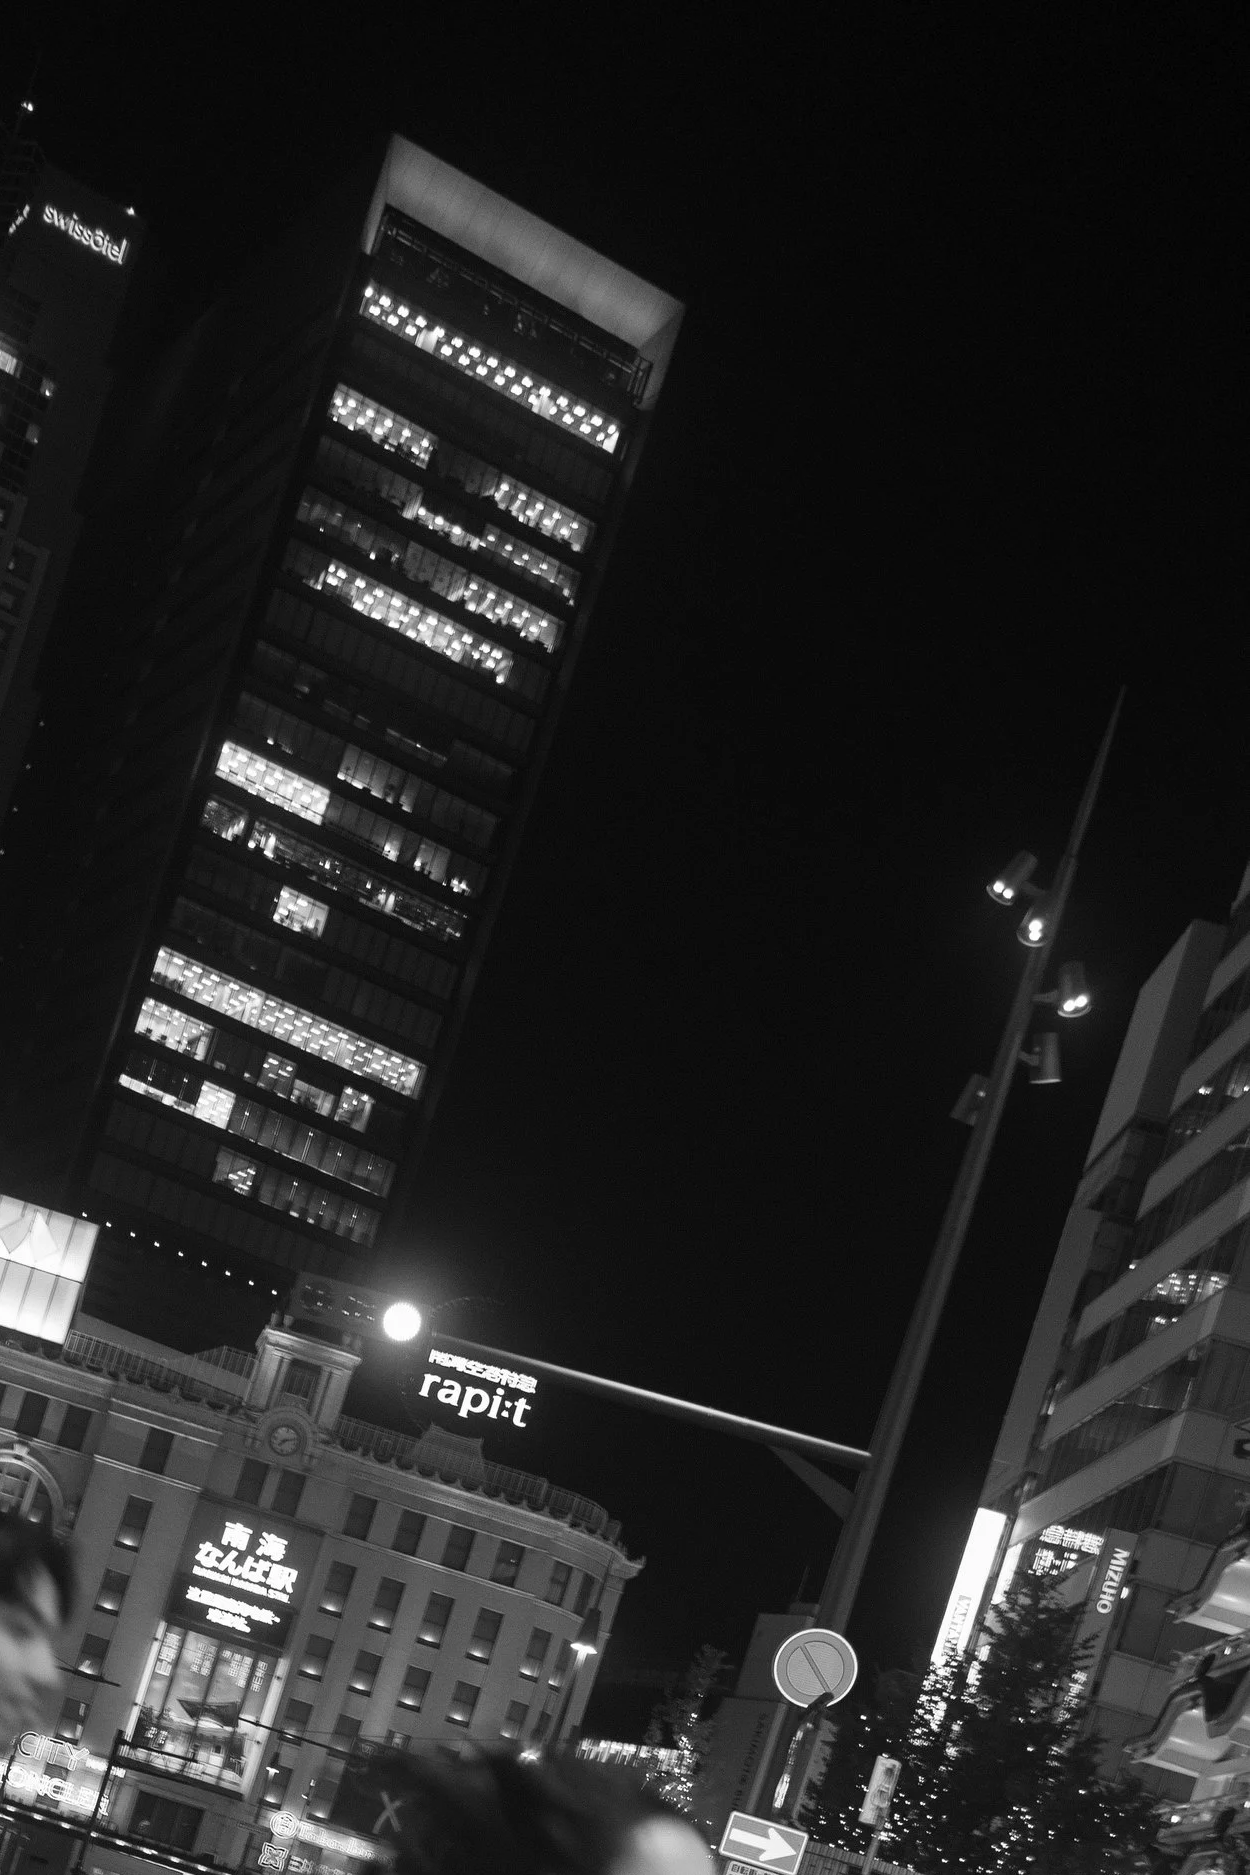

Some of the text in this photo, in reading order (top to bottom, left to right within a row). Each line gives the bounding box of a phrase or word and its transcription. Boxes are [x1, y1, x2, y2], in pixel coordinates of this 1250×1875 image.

[43, 204, 128, 265] swissôtel
[195, 1541, 298, 1593] なんば駅
[221, 1521, 288, 1562] 南海
[1096, 1547, 1131, 1614] MIZUHO
[18, 1731, 90, 1771] CITY
